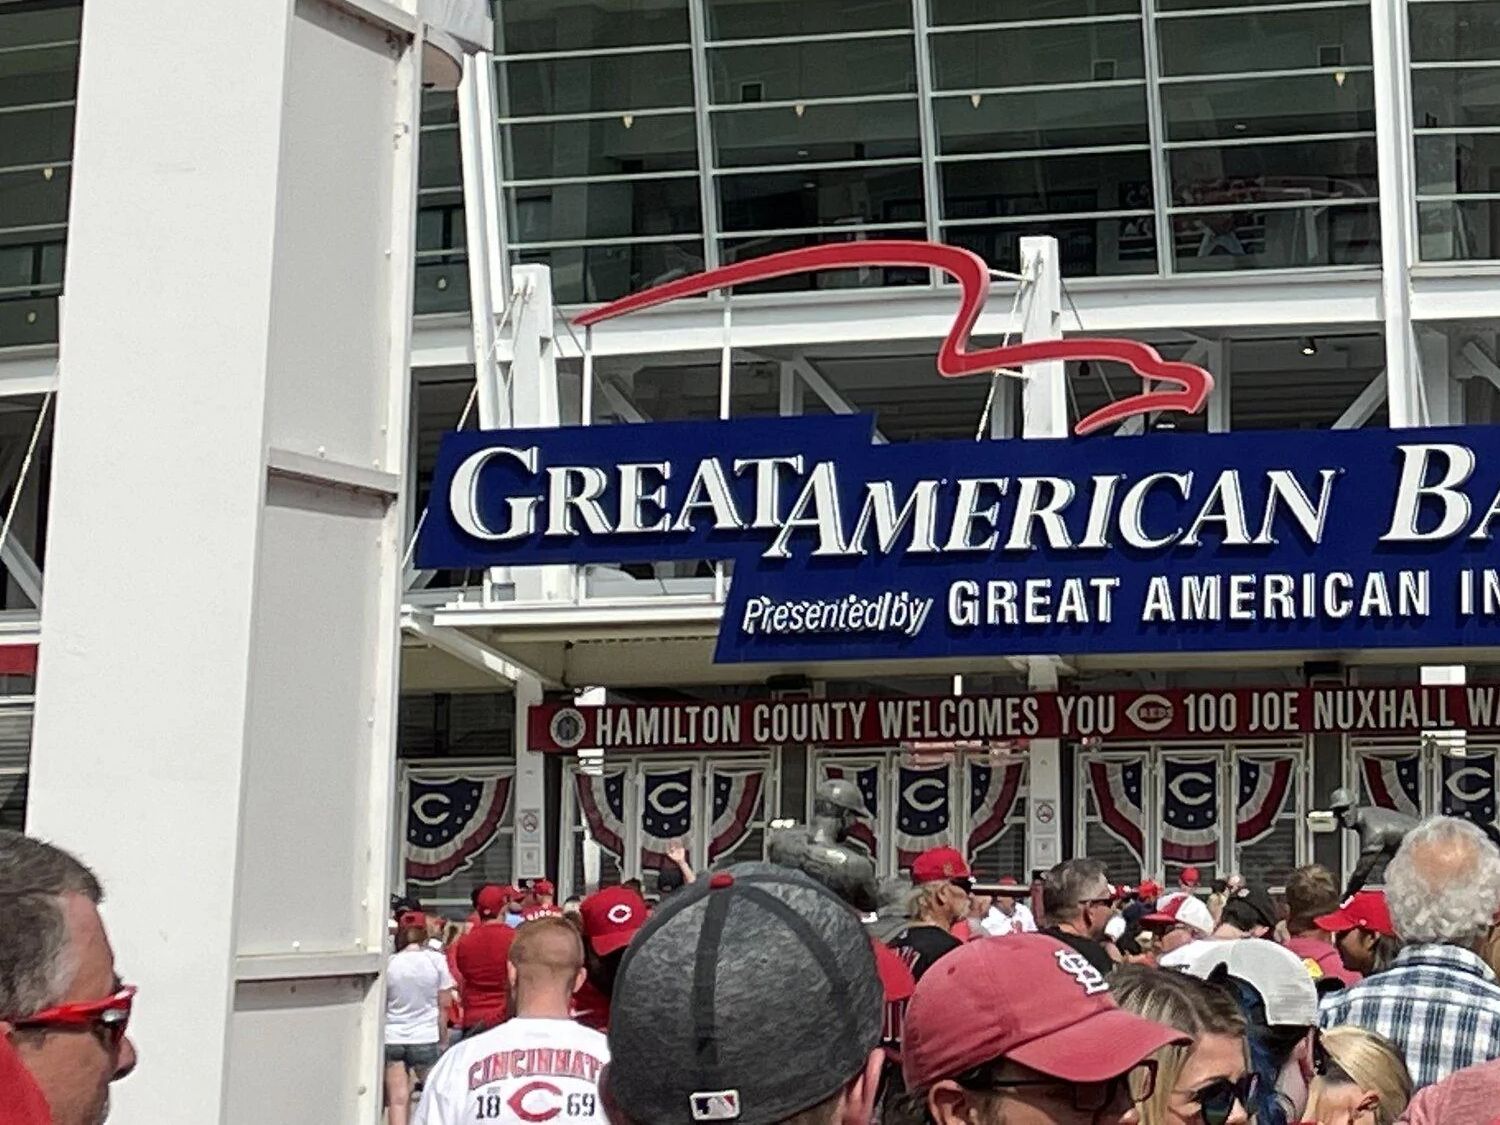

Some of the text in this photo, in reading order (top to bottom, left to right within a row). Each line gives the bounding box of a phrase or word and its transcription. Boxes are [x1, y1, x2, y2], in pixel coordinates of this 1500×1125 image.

[450, 445, 804, 541] GREAT
[762, 462, 1339, 559] AMERICAN
[743, 592, 892, 634] Presented
[948, 576, 1120, 627] GREAT
[1142, 569, 1431, 623] AMERICAN
[595, 704, 741, 746] HAMILTON
[752, 701, 867, 743] COUNTY
[878, 696, 1040, 741] WELCOMES
[1056, 694, 1117, 735] YOU
[1182, 692, 1237, 732] 100
[1248, 691, 1300, 731] JOE
[1314, 687, 1456, 730] NUXHALL
[468, 1046, 602, 1091] CINCINNAT
[475, 1095, 501, 1120] 18
[566, 1092, 596, 1117] 69
